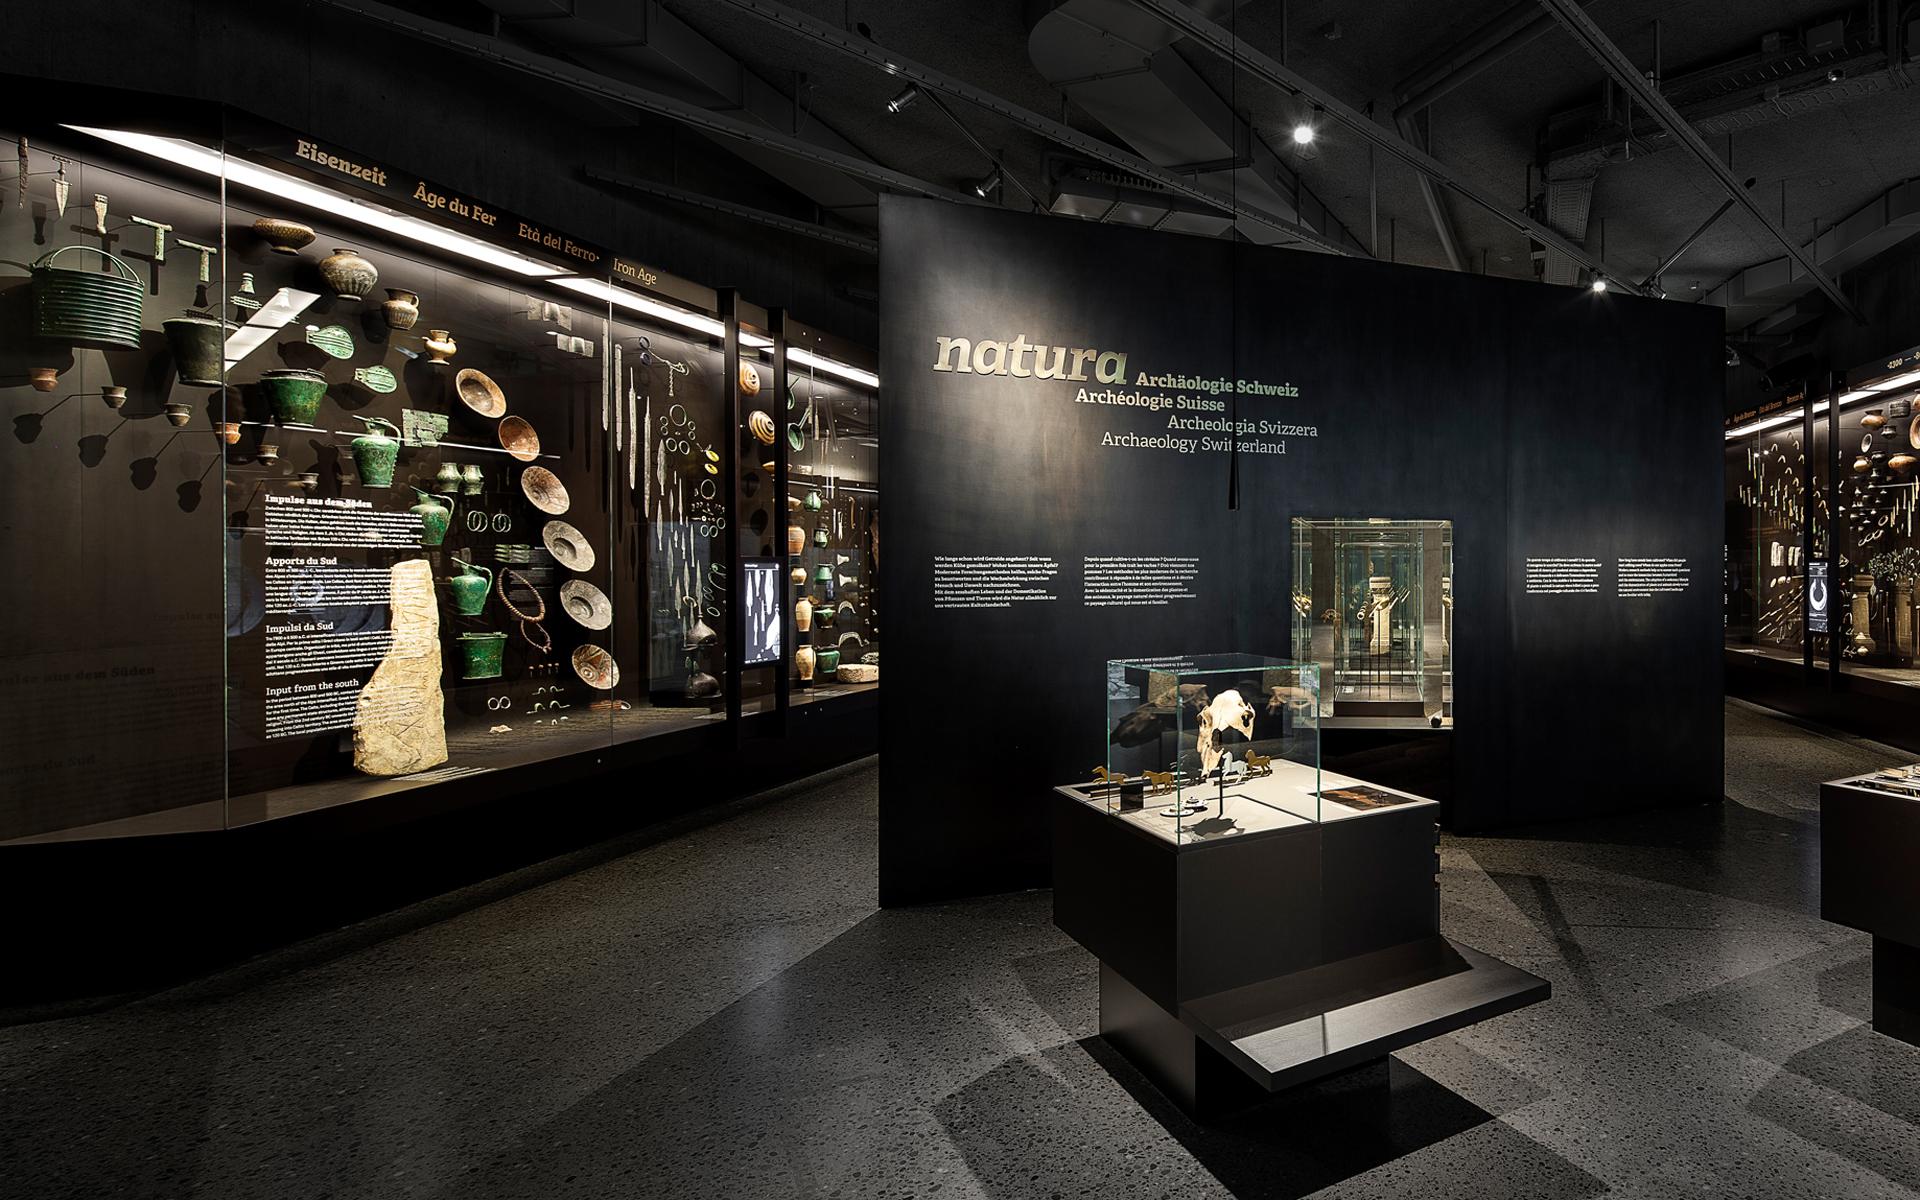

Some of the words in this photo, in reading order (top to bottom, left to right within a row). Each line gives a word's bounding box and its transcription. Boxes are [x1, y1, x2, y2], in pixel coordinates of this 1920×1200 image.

[295, 139, 388, 188] Eisenzeit
[413, 182, 446, 208] Âge
[448, 198, 470, 218] du
[472, 204, 497, 227] Fer
[518, 222, 540, 244] Età
[543, 232, 562, 251] del
[613, 258, 636, 277] Iron
[637, 268, 657, 285] Age
[932, 334, 1128, 386] natura
[1135, 371, 1234, 395] Archäologie
[1236, 380, 1300, 398] Schweiz
[1075, 388, 1174, 411] Archéologie
[1176, 395, 1226, 412] Suisse
[1167, 414, 1256, 436] Archeologia
[1258, 420, 1318, 438] Svizzera
[1101, 431, 1198, 453] Archaeology
[1200, 436, 1286, 455] Switzerland
[265, 494, 305, 504] Impulse
[265, 557, 304, 566] Apports
[266, 623, 302, 634] Impulsi
[304, 622, 315, 630] da
[317, 622, 334, 630] Sud
[266, 687, 292, 696] Input
[294, 684, 316, 692] from
[335, 678, 359, 688] south
